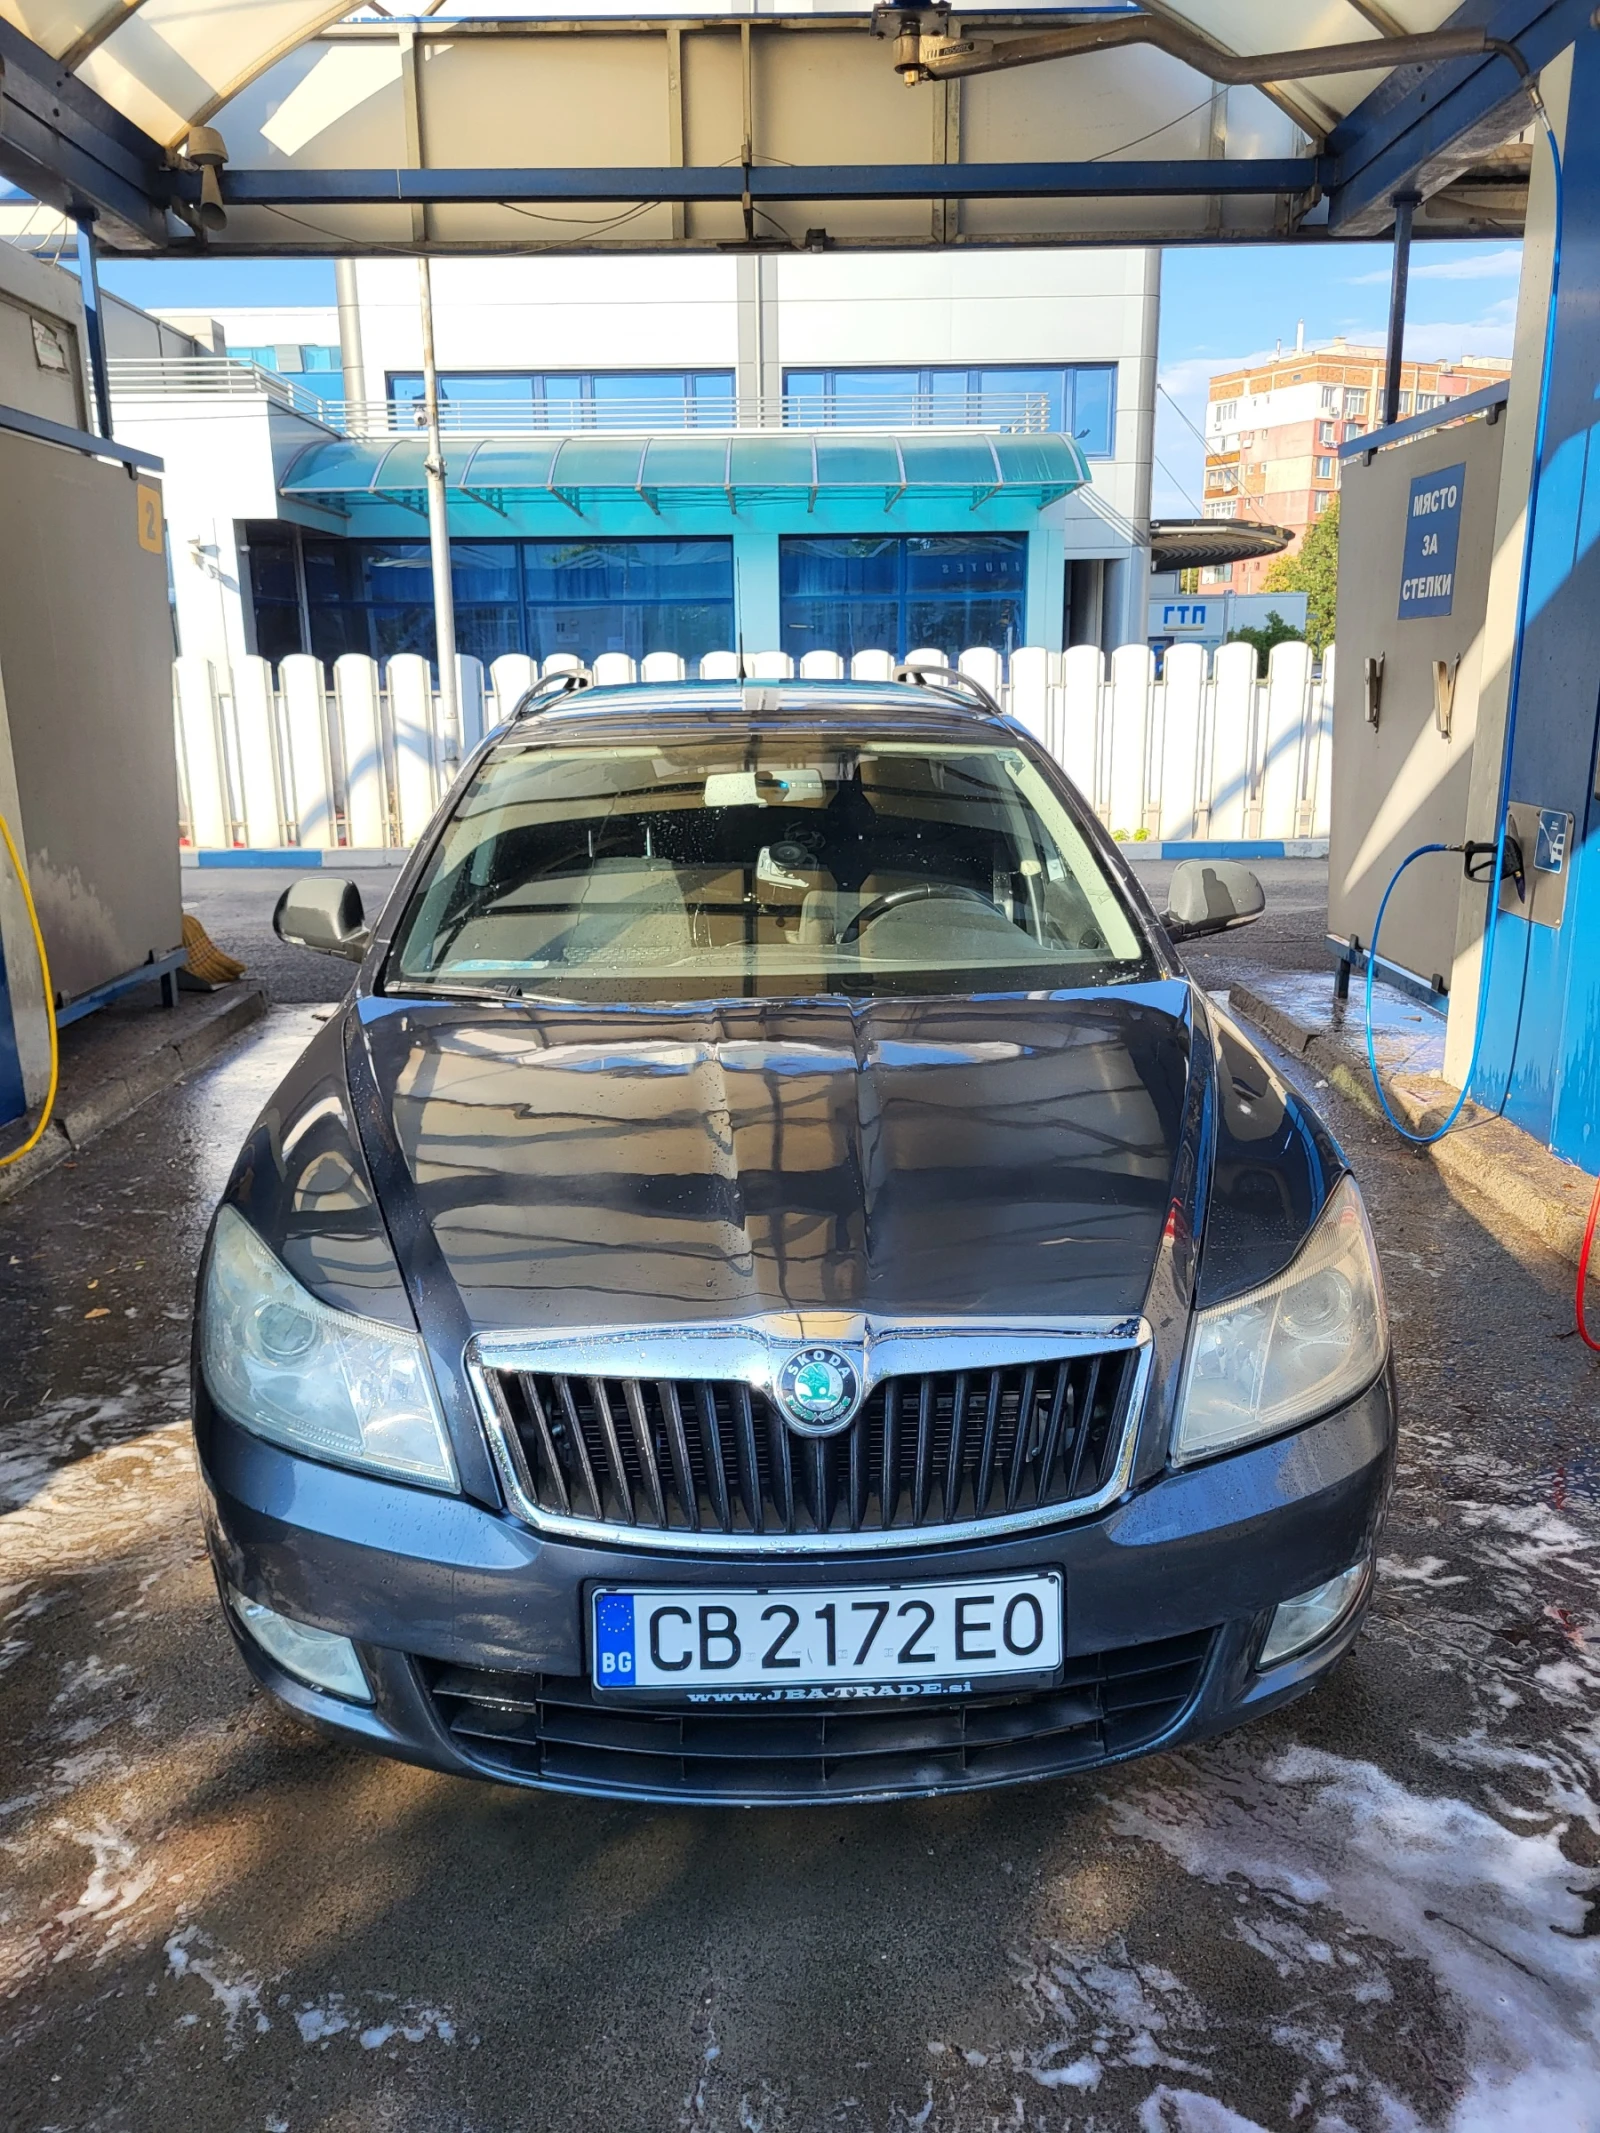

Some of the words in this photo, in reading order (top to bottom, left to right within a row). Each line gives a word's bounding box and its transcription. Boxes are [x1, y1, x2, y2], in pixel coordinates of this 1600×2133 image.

[1412, 485, 1457, 517] МЯСТО
[145, 500, 156, 540] 2
[1421, 533, 1438, 557] ЗА
[1402, 573, 1452, 601] СТЕЛКИ
[1163, 605, 1206, 624] ГТП
[760, 1601, 936, 1670] 2172
[602, 1651, 632, 1673] BG
[686, 1681, 973, 1703] www.JBA-TRADE.si
